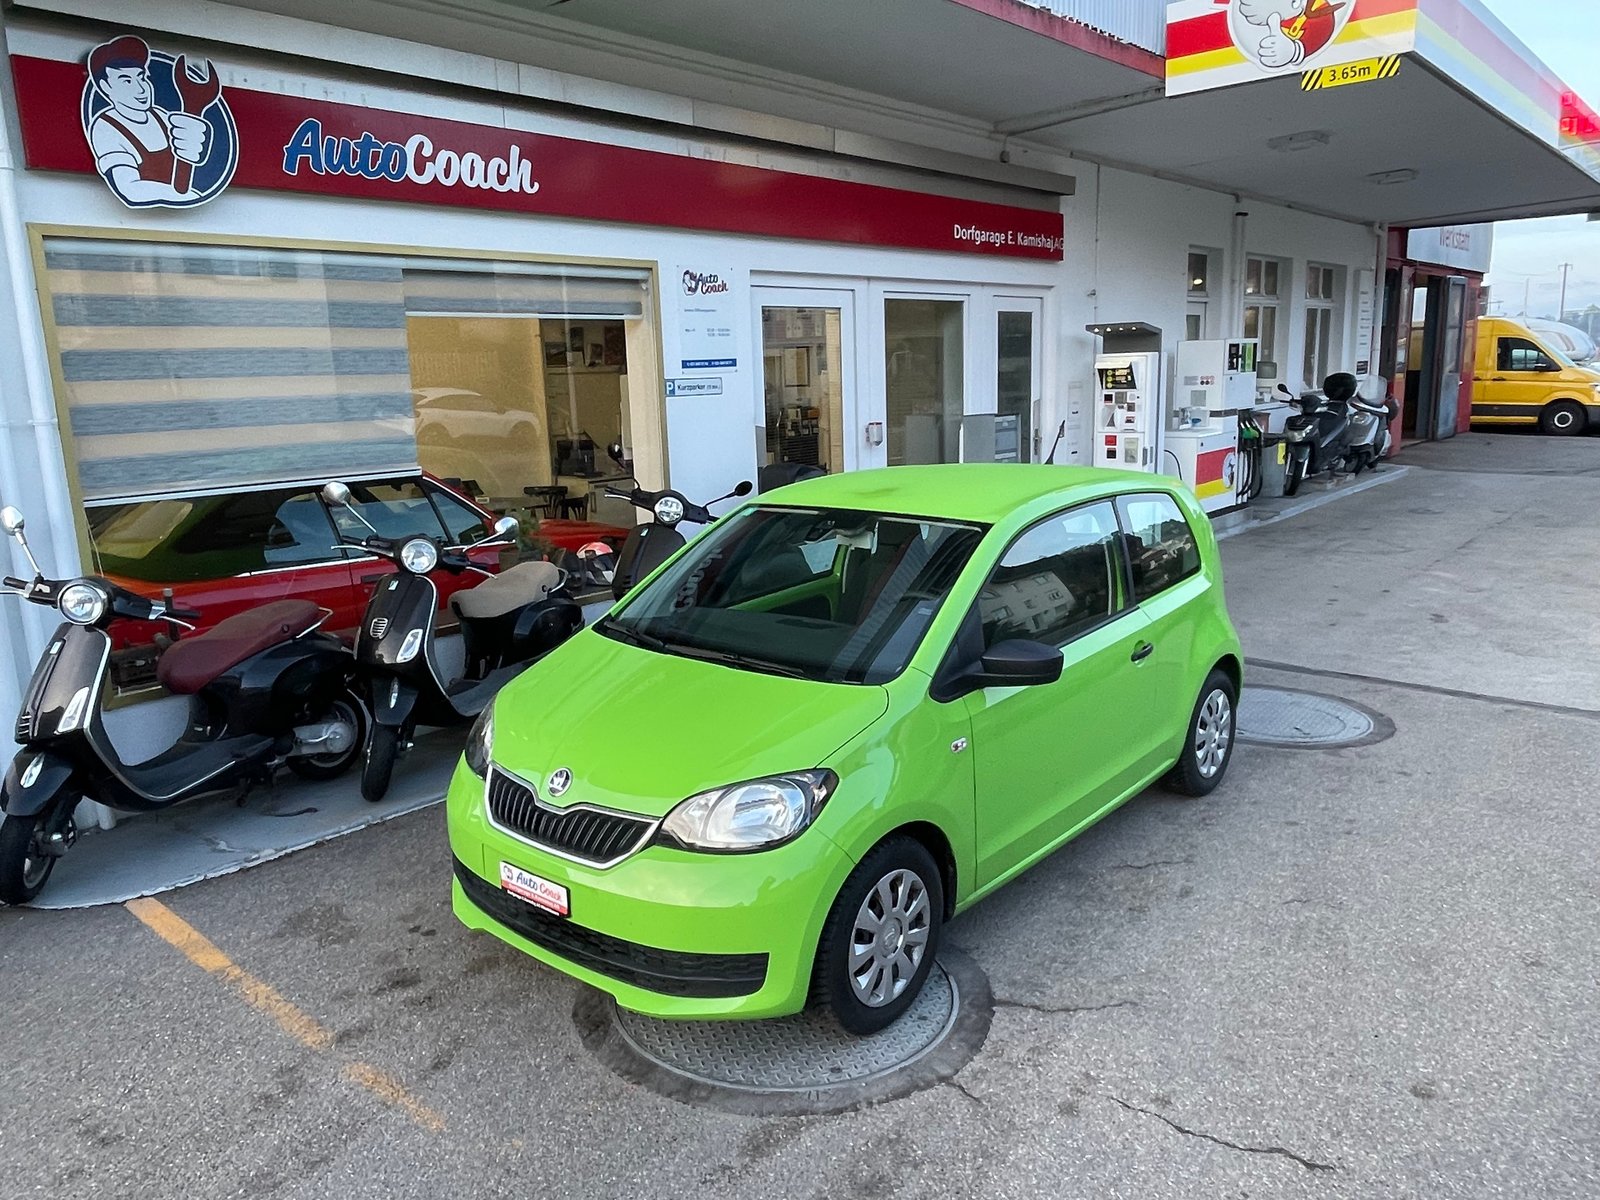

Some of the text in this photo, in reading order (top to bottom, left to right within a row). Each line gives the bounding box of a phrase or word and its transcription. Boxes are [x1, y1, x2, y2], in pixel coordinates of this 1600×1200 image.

[1329, 66, 1370, 82] 3.65m
[954, 224, 1005, 246] Dorfgarage
[1007, 231, 1015, 244] E.
[698, 272, 719, 284] Auto
[700, 280, 729, 295] Coach
[516, 872, 538, 891] Auto
